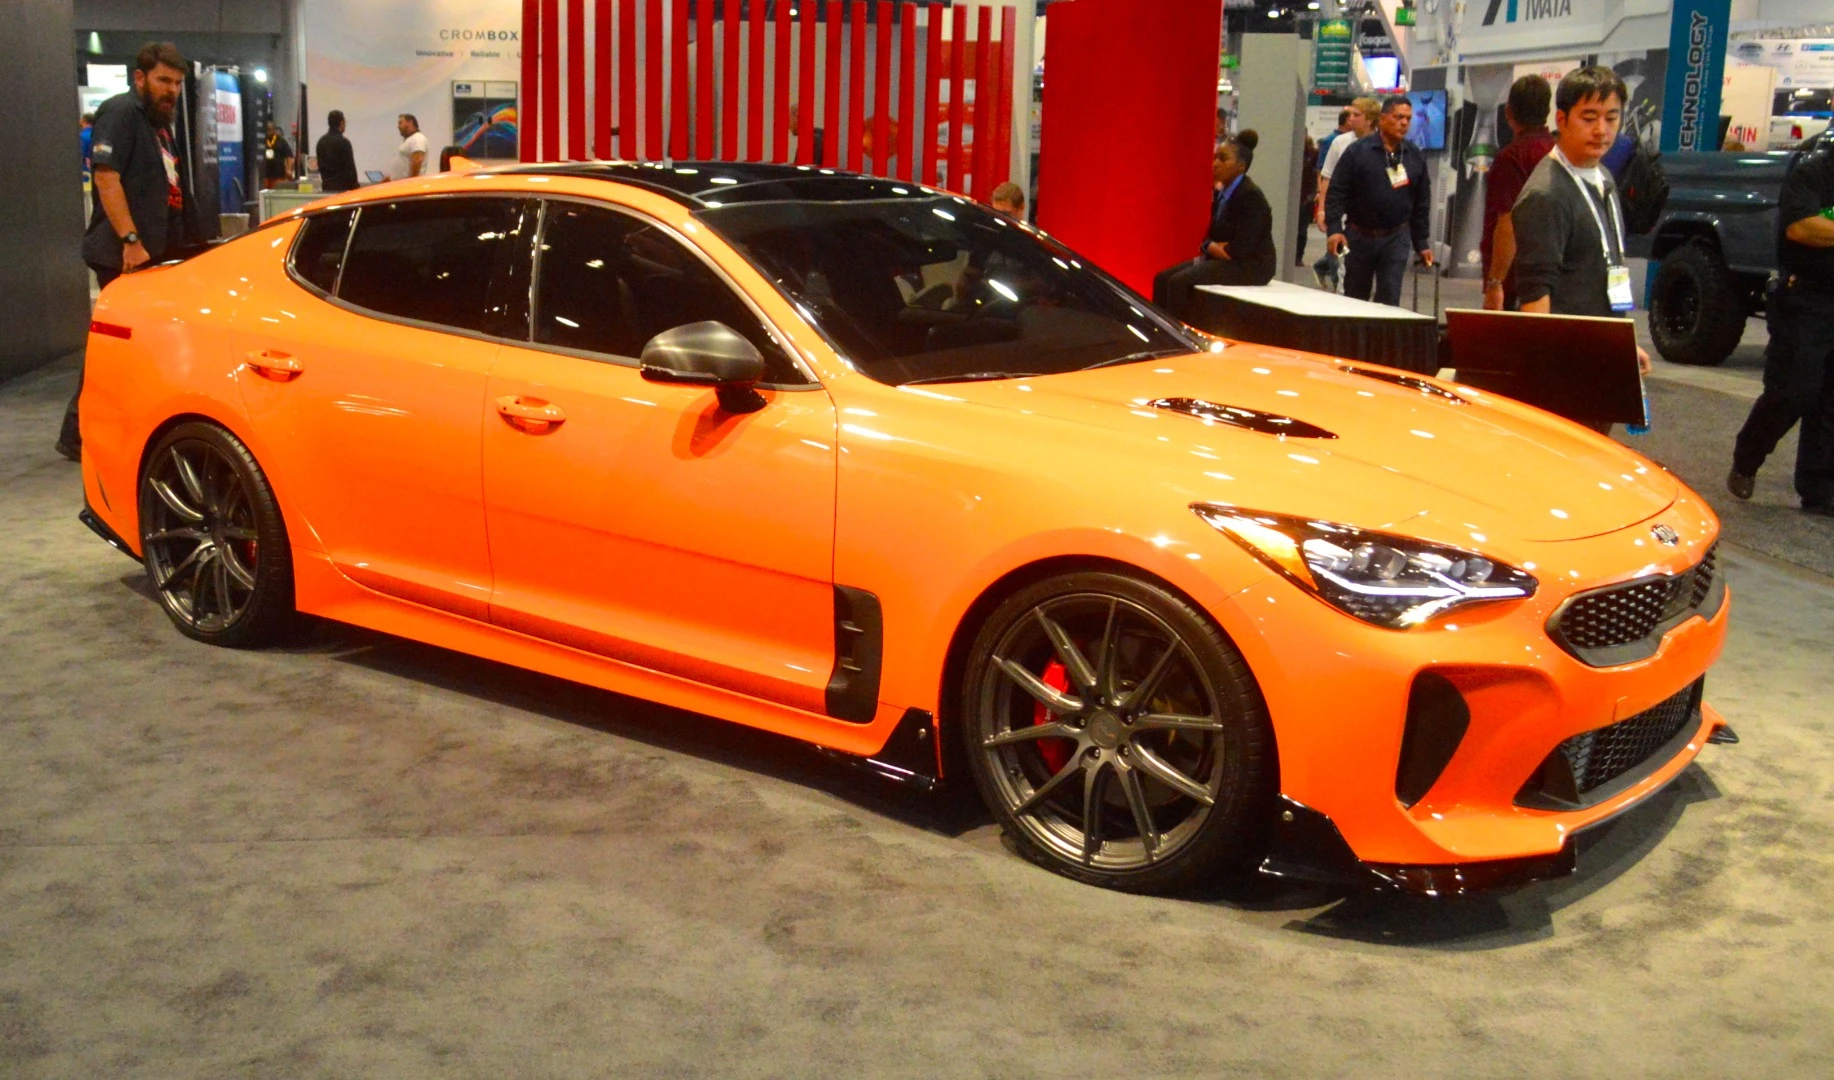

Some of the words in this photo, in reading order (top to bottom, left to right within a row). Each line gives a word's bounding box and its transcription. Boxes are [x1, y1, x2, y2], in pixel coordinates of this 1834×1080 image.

[439, 29, 519, 41] CROMBOX
[415, 49, 454, 57] Innovative
[470, 50, 500, 58] Reliable
